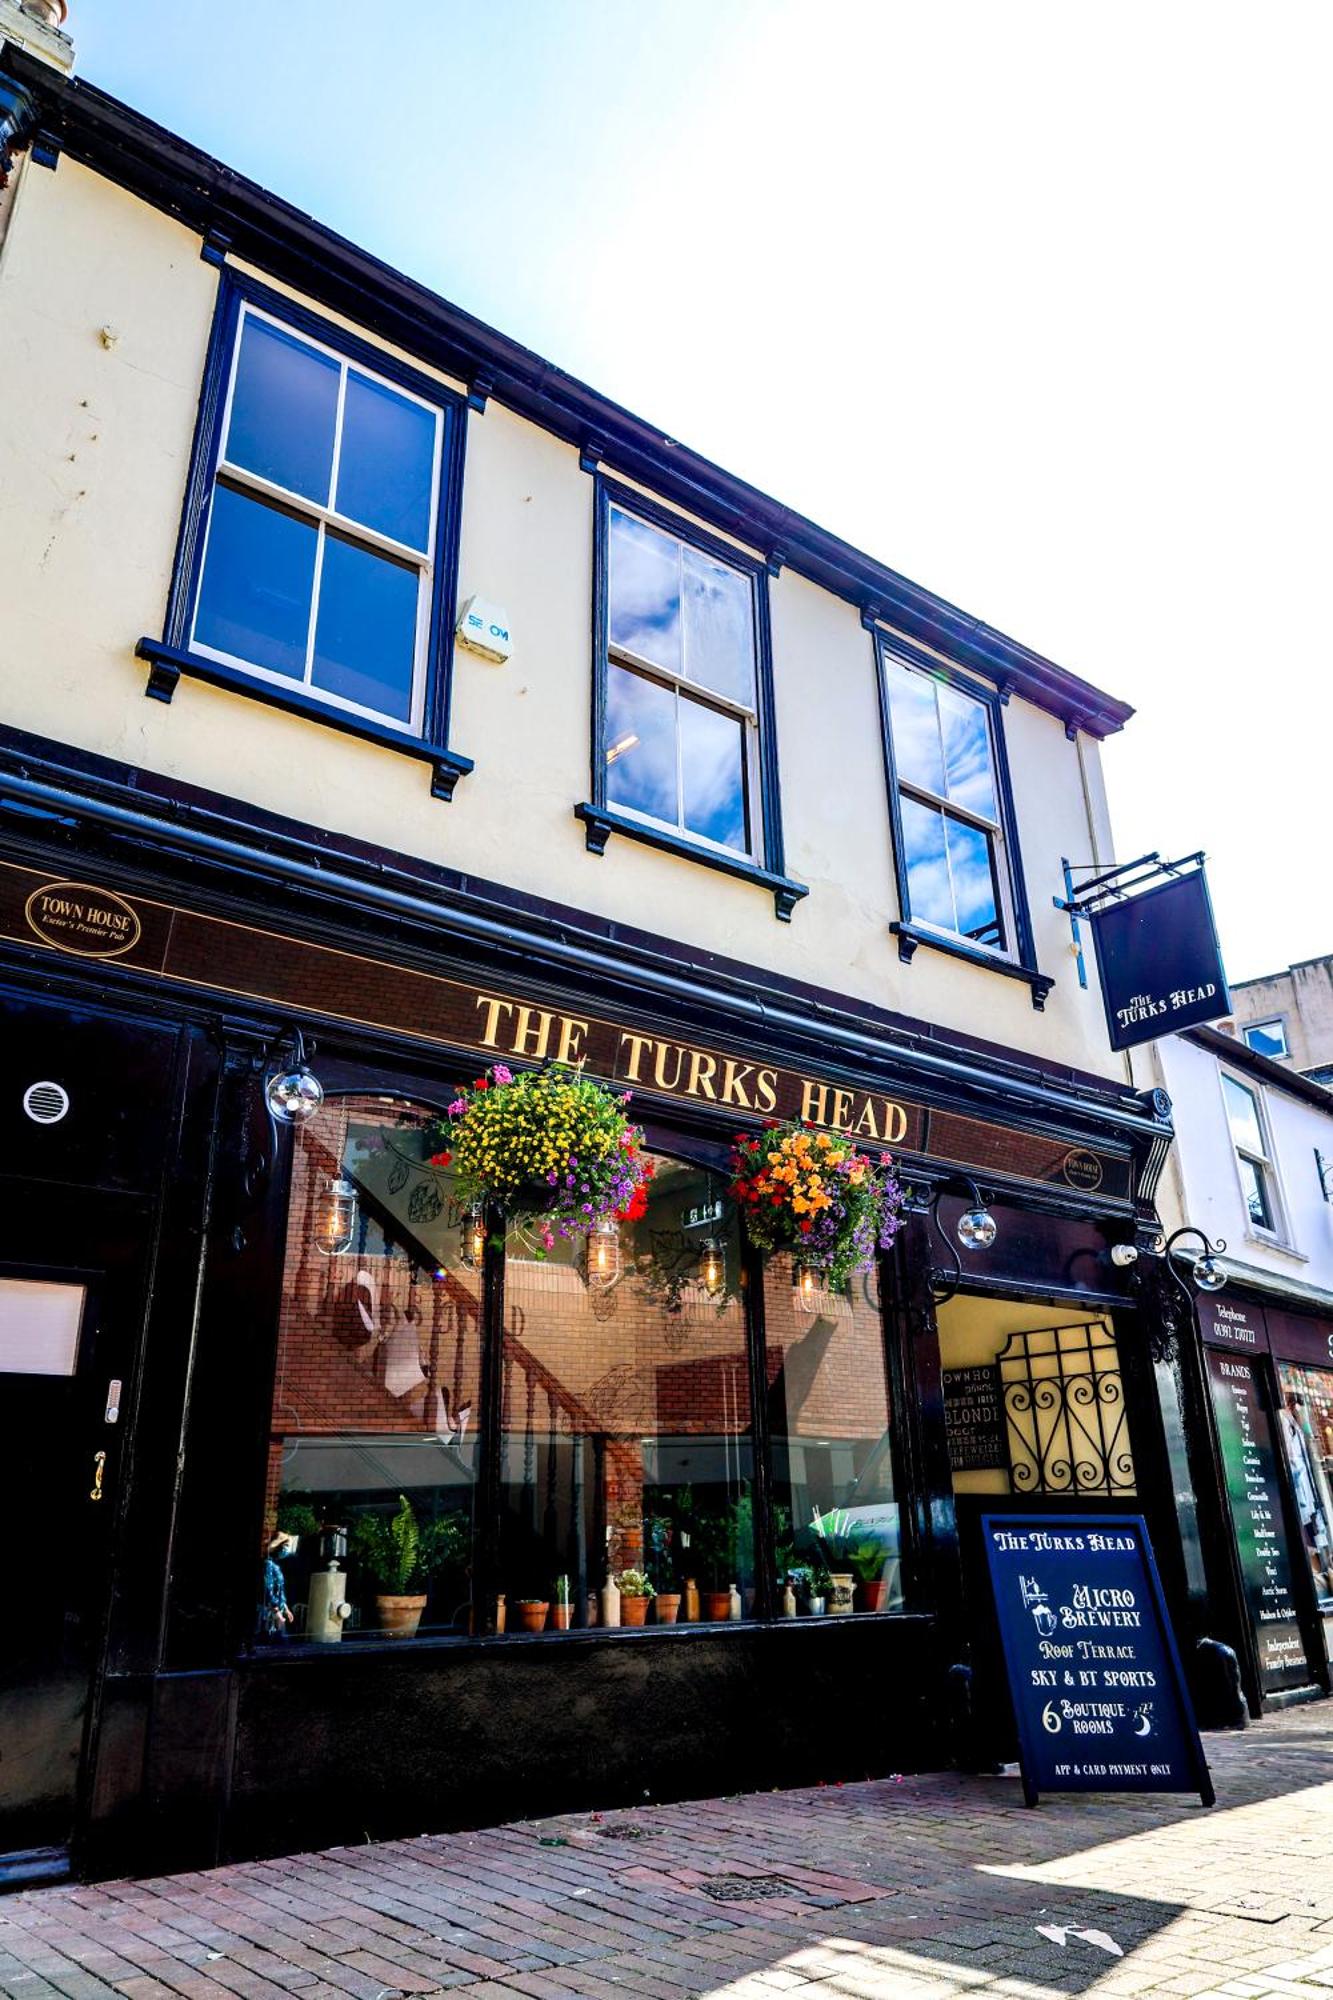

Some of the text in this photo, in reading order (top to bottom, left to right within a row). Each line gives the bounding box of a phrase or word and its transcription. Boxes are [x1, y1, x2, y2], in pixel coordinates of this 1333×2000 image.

[41, 895, 131, 931] TOWN HOUSE
[42, 914, 125, 940] Exeter's Premier Pub
[1116, 983, 1216, 1028] TURKS HEAD
[1130, 994, 1152, 1009] THE
[476, 995, 908, 1144] THE TURKS HEAD
[1215, 1304, 1247, 1322] Telephone
[1219, 1362, 1251, 1379] BRANDS
[993, 1532, 1135, 1551] THE TURKS HEAD
[1072, 1583, 1135, 1611] MICRO
[1059, 1606, 1141, 1628] BREWERY
[1039, 1640, 1136, 1660] ROOF TERRACE
[1266, 1636, 1300, 1654] Independent
[1265, 1655, 1285, 1671] Family
[1031, 1670, 1156, 1687] SKY & BT SPORTS
[1042, 1699, 1126, 1733] 6 BOUTIQUE
[1073, 1719, 1113, 1734] ROOMS
[1055, 1764, 1171, 1776] APP & CARD PAYMENT ONLY
